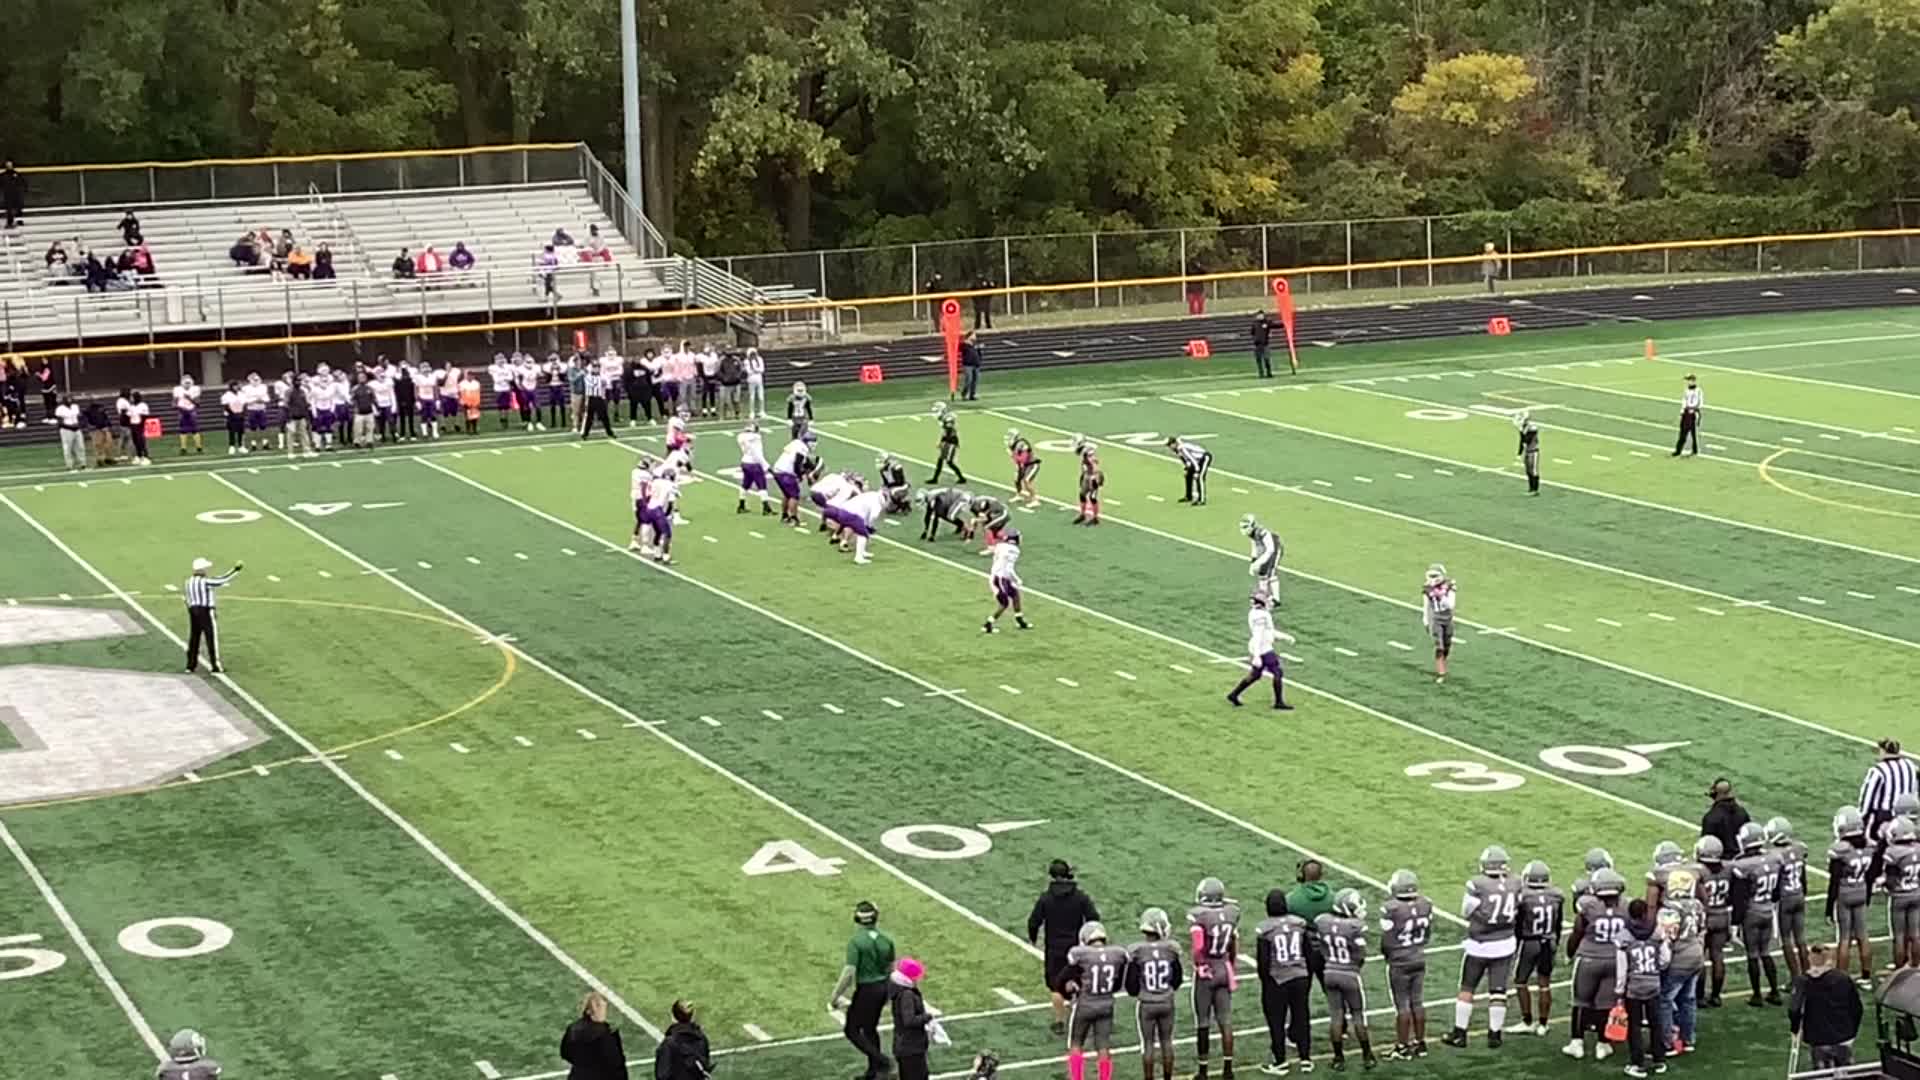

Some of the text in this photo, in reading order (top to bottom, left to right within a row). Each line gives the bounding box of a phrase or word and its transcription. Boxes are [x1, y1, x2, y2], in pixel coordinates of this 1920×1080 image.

[1487, 892, 1517, 925] 74
[1532, 904, 1553, 935] 21
[1208, 923, 1233, 955] 17
[1274, 931, 1301, 963] 84
[1323, 934, 1351, 964] 18
[1090, 964, 1115, 994] 13
[1143, 959, 1170, 991] 82
